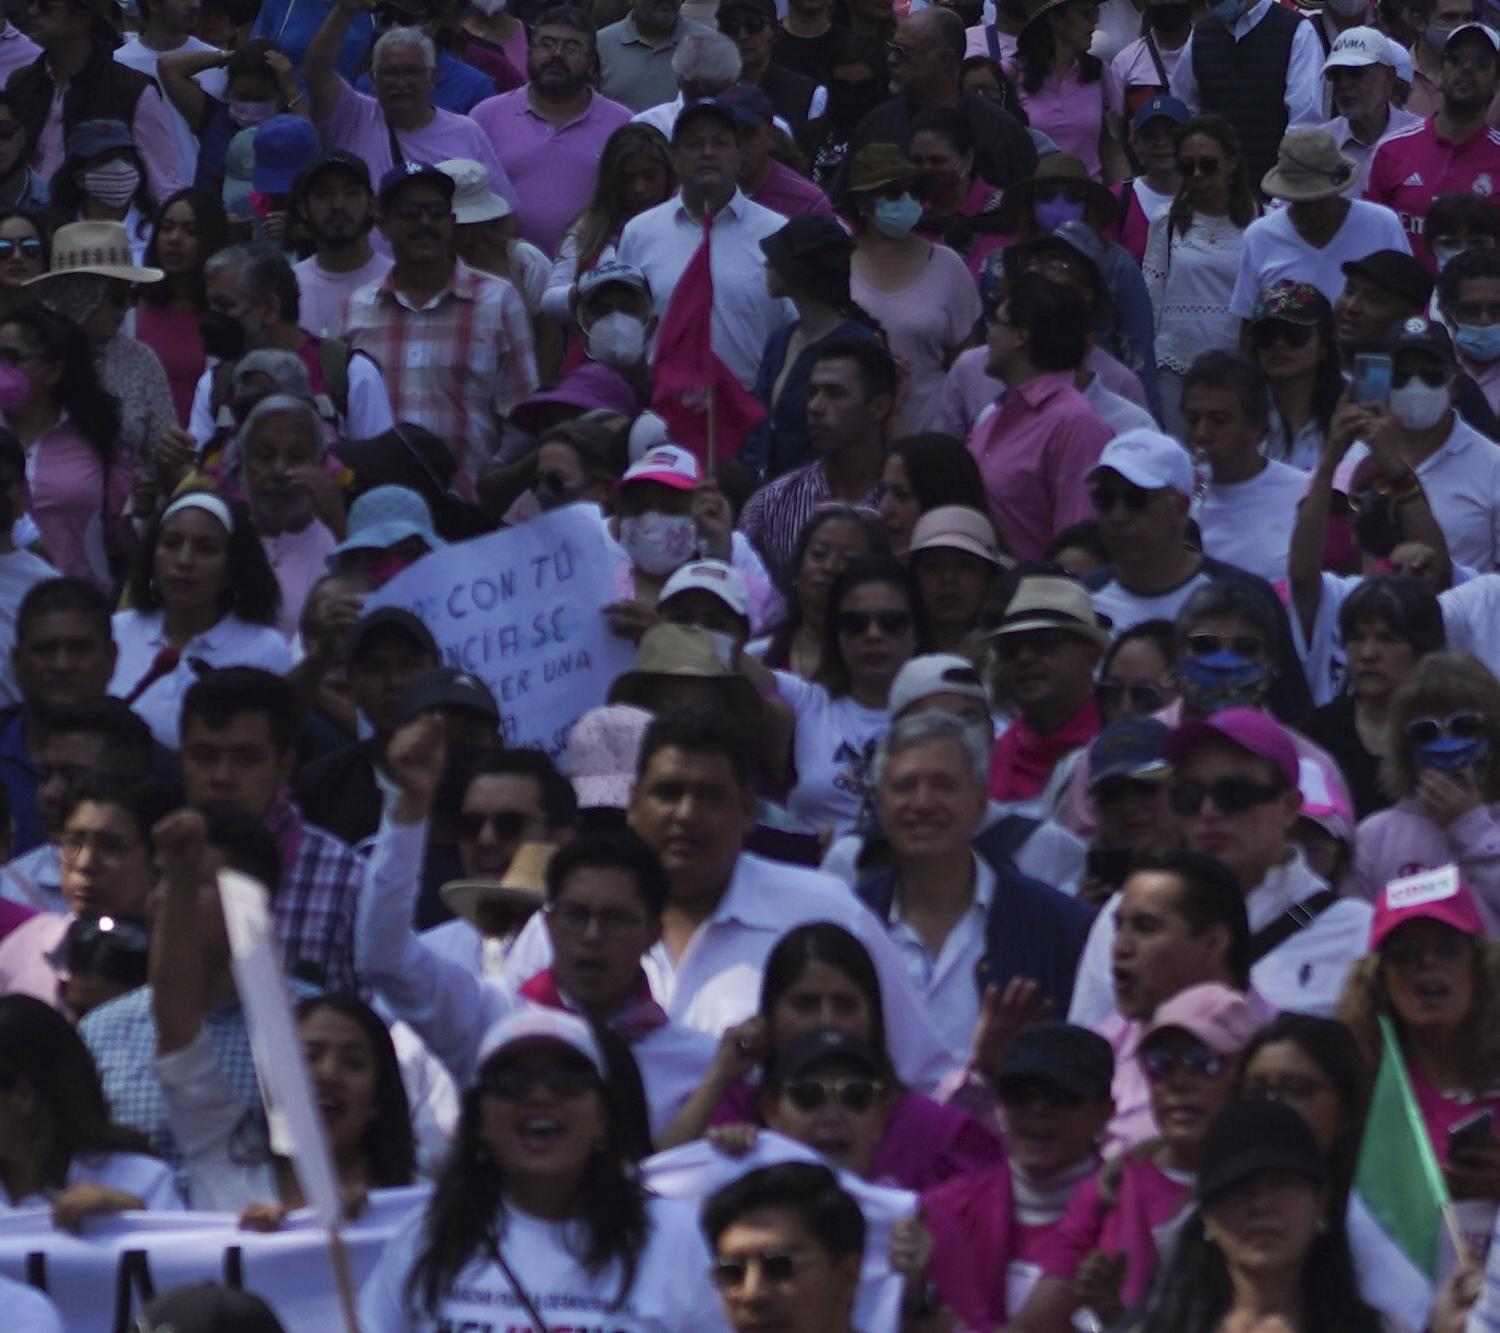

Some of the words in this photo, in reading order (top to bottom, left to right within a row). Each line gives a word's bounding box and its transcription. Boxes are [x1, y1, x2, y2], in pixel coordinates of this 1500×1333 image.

[446, 571, 516, 620] CON
[528, 539, 575, 586] TU
[543, 650, 592, 684] UNA
